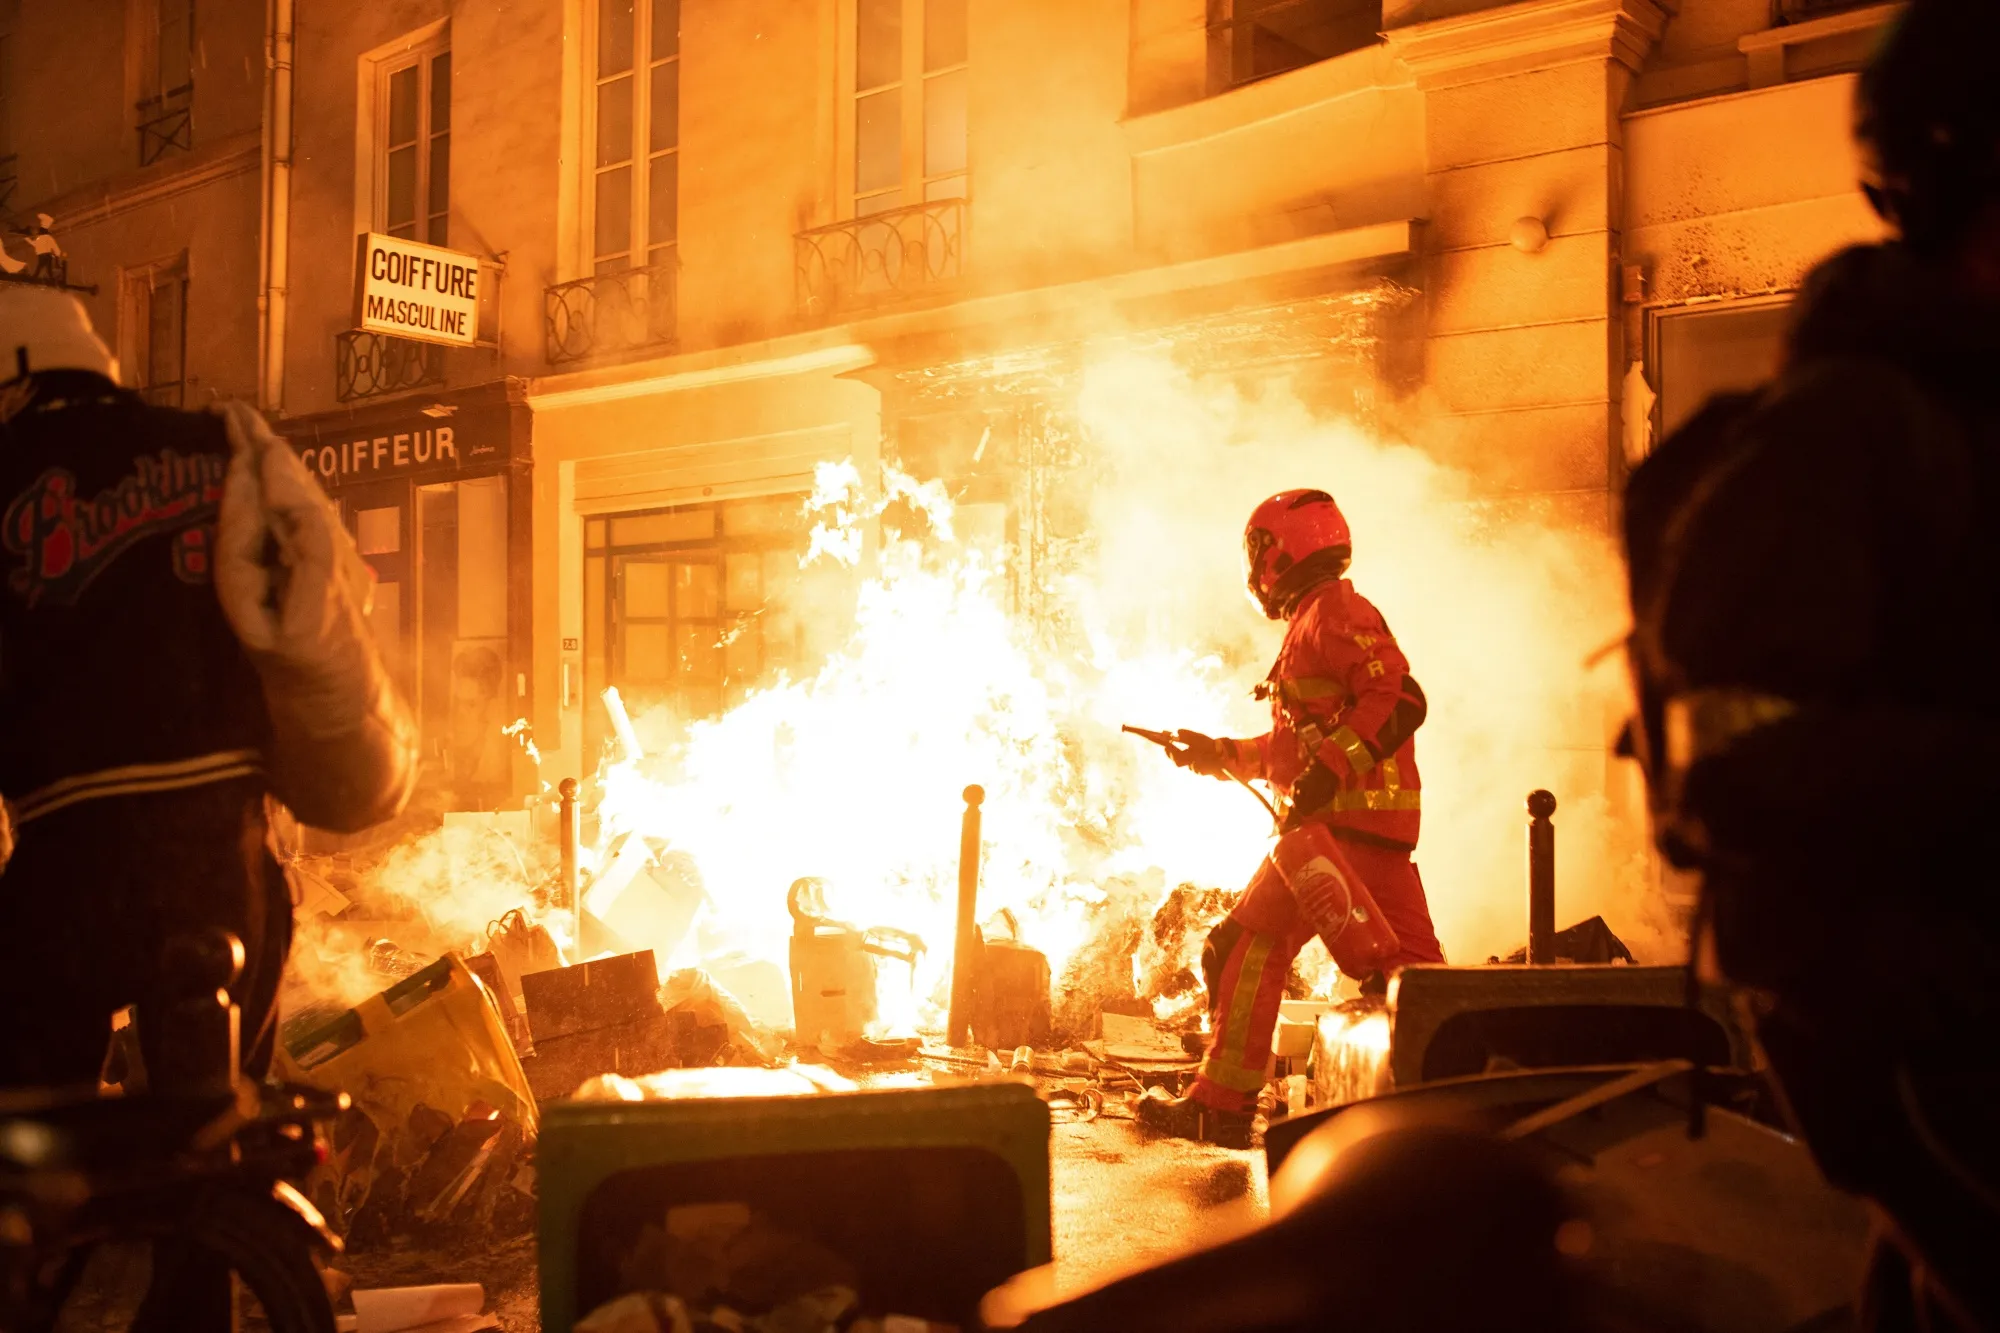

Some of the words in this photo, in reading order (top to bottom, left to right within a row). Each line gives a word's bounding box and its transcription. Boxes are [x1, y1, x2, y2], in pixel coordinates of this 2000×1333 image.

[371, 247, 478, 300] COIFFURE
[367, 294, 467, 336] MASCULINE
[301, 426, 455, 477] COIFFEUR
